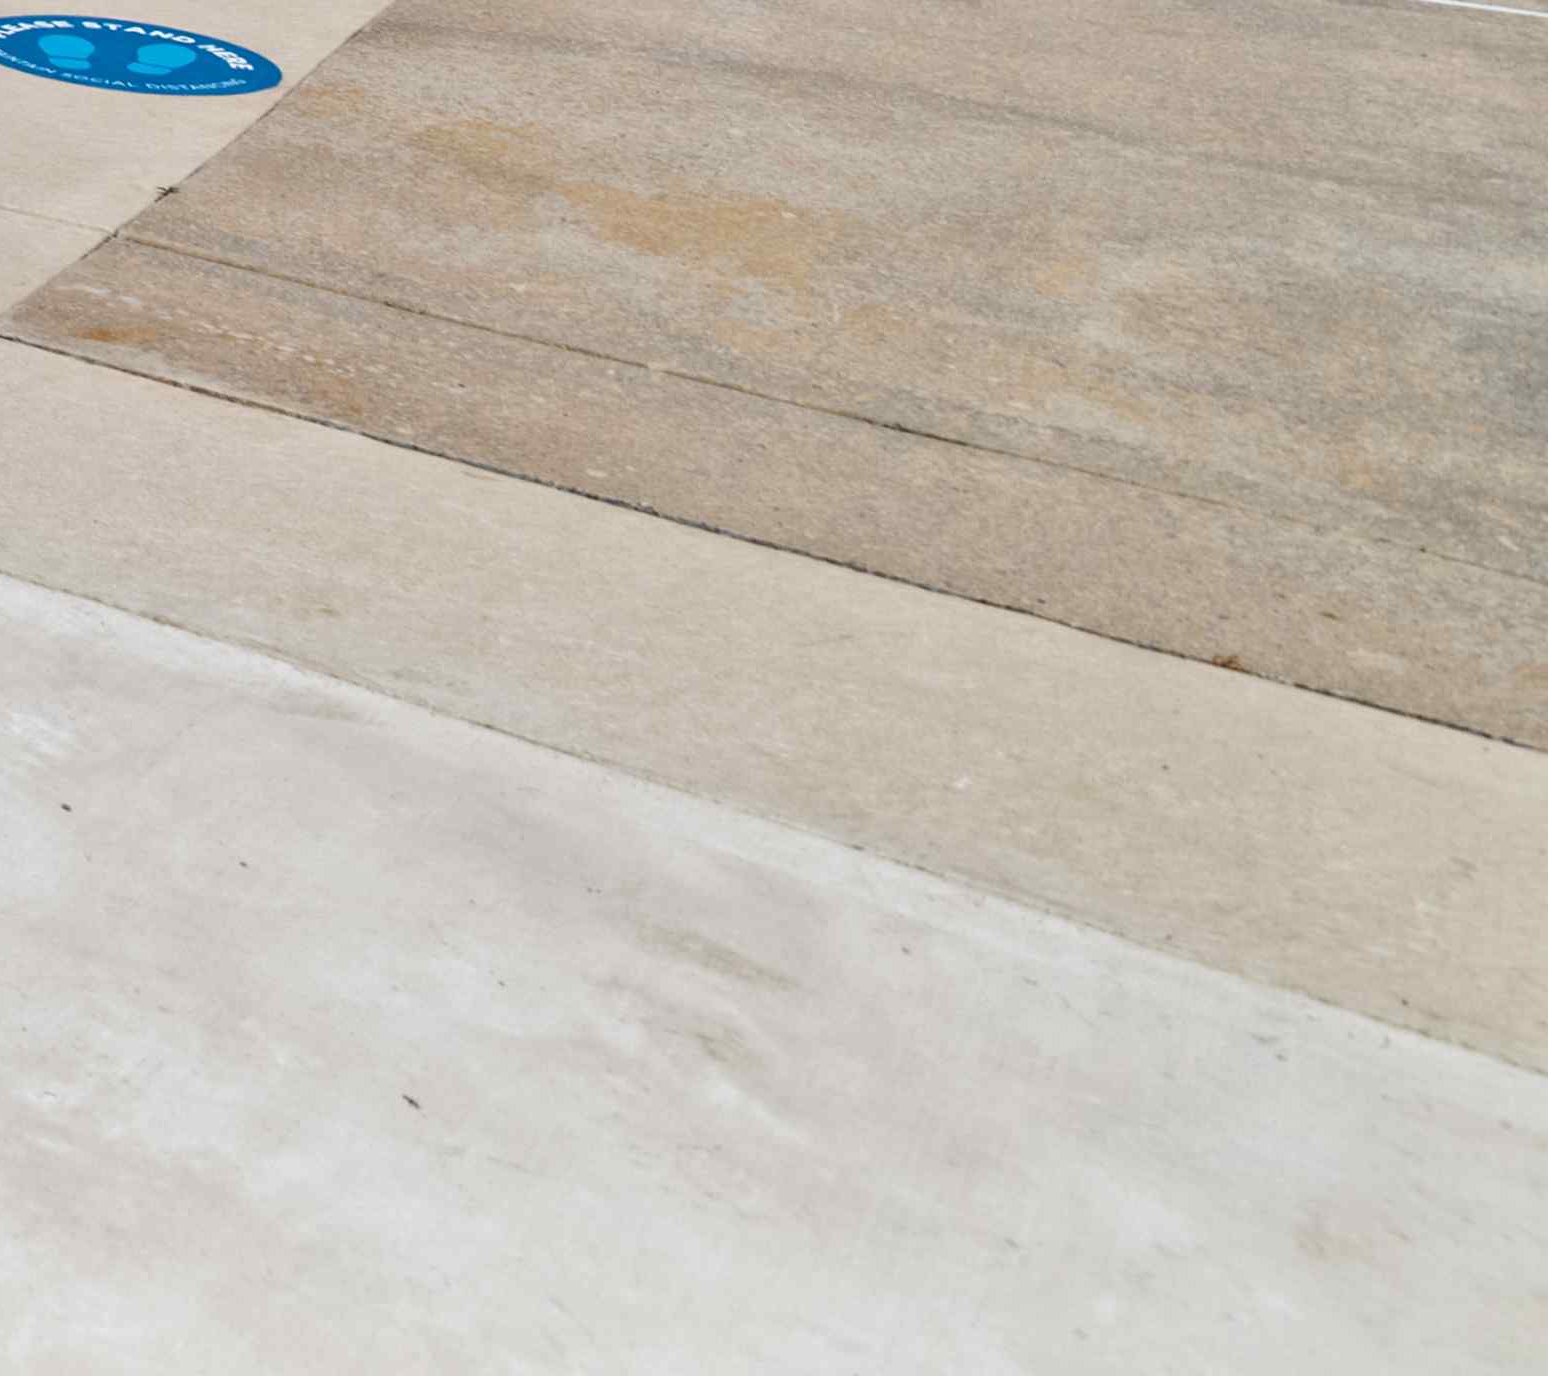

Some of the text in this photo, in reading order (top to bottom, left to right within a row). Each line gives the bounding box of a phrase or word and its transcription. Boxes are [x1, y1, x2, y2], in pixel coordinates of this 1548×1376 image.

[81, 21, 196, 44] STAND
[197, 44, 255, 71] HERE
[61, 72, 137, 88] SOCIAL
